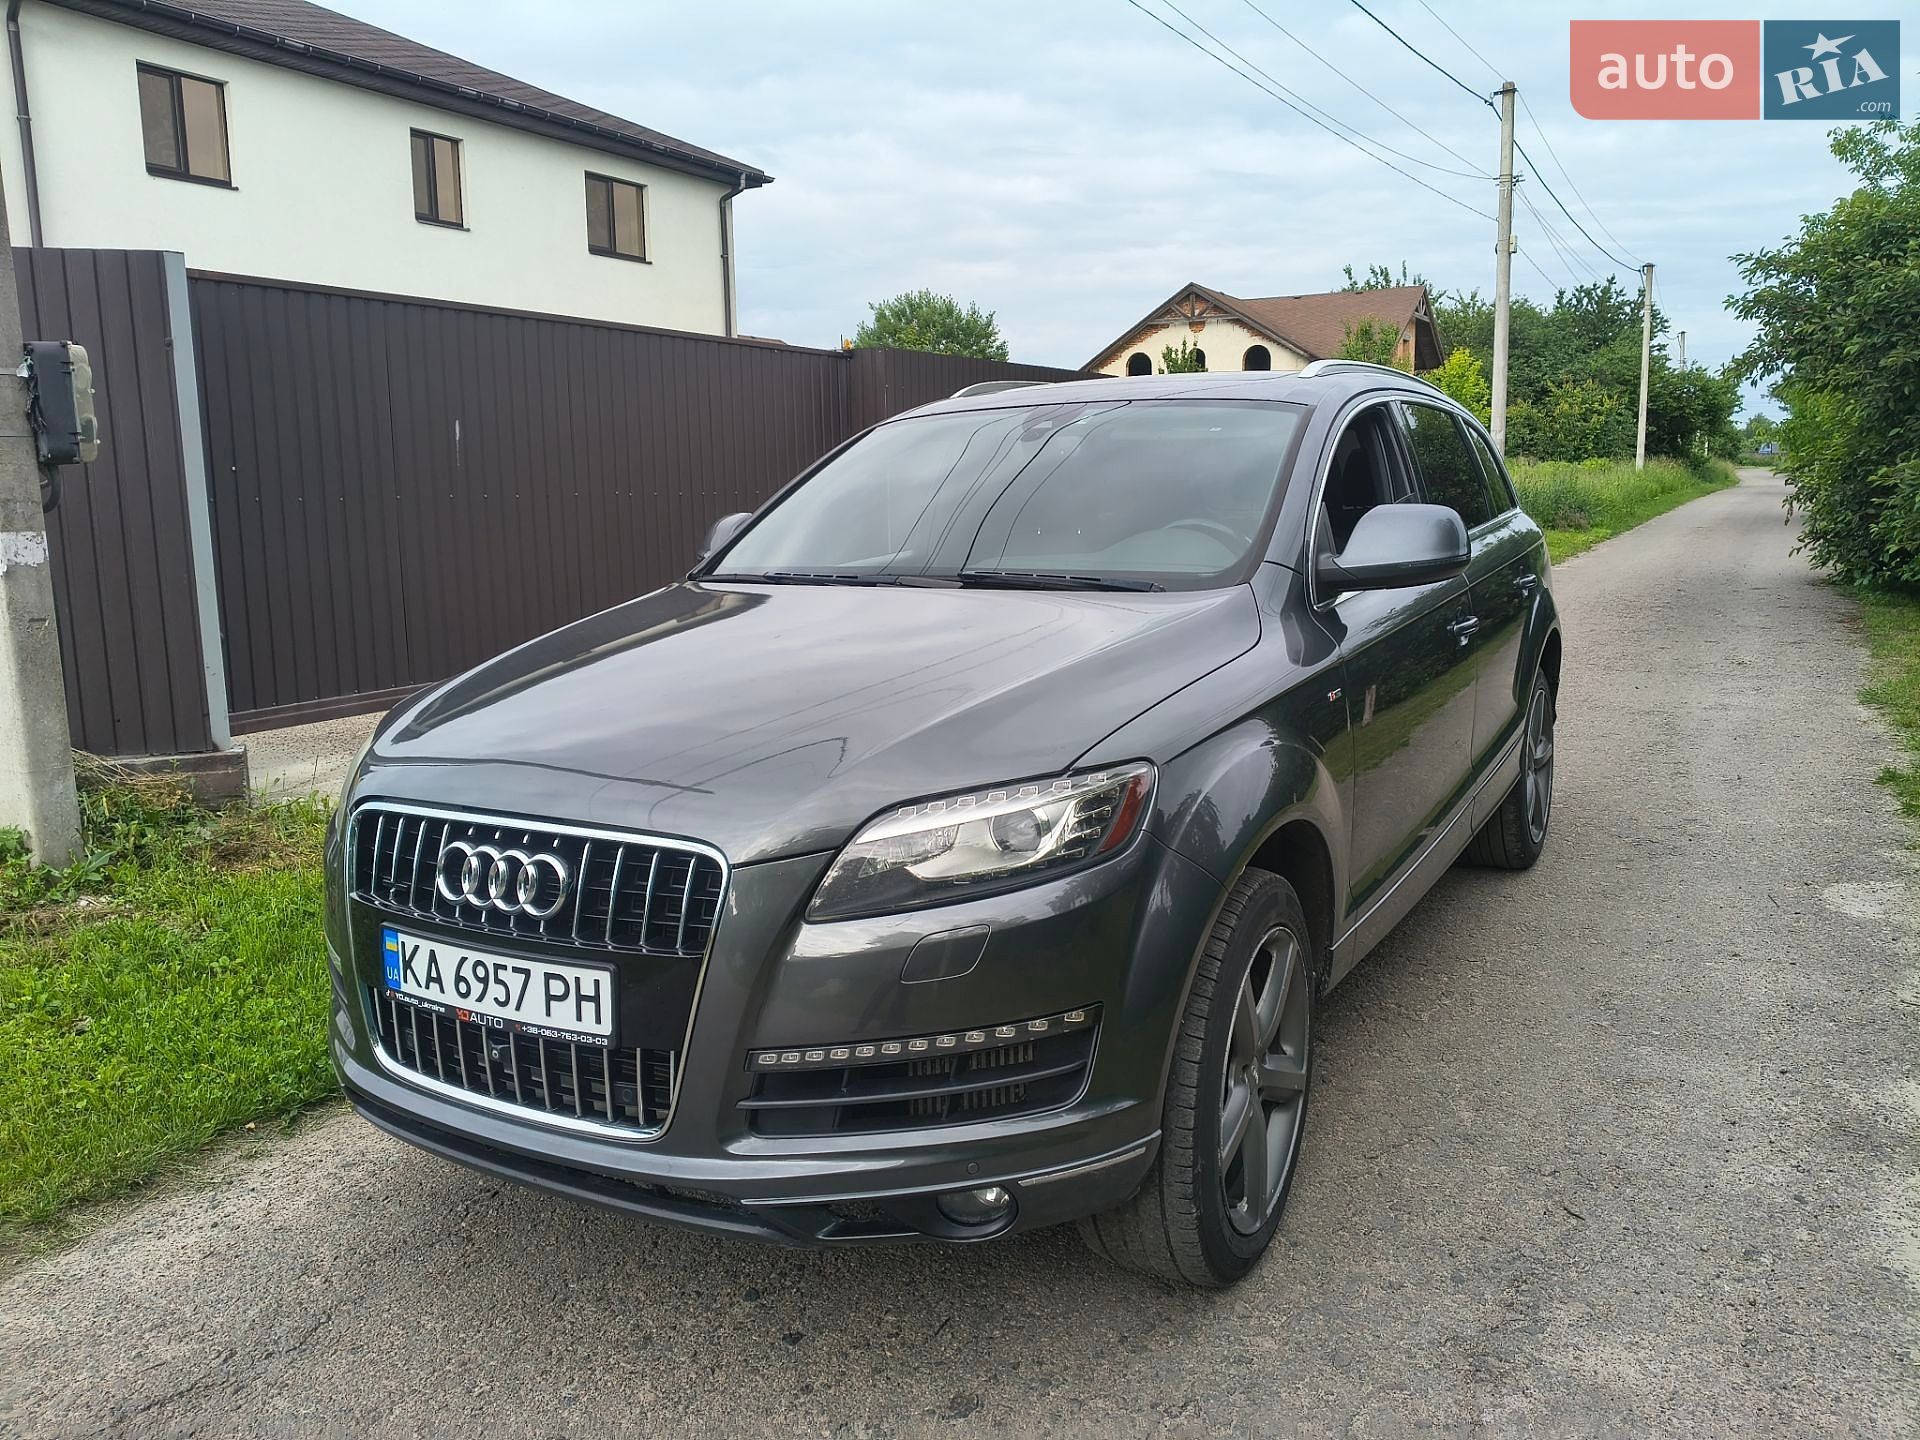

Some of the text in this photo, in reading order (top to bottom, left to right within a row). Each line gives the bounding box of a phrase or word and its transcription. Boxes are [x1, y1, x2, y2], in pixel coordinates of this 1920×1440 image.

[386, 966, 399, 981] UA
[400, 941, 602, 1025] KA 6957 PH
